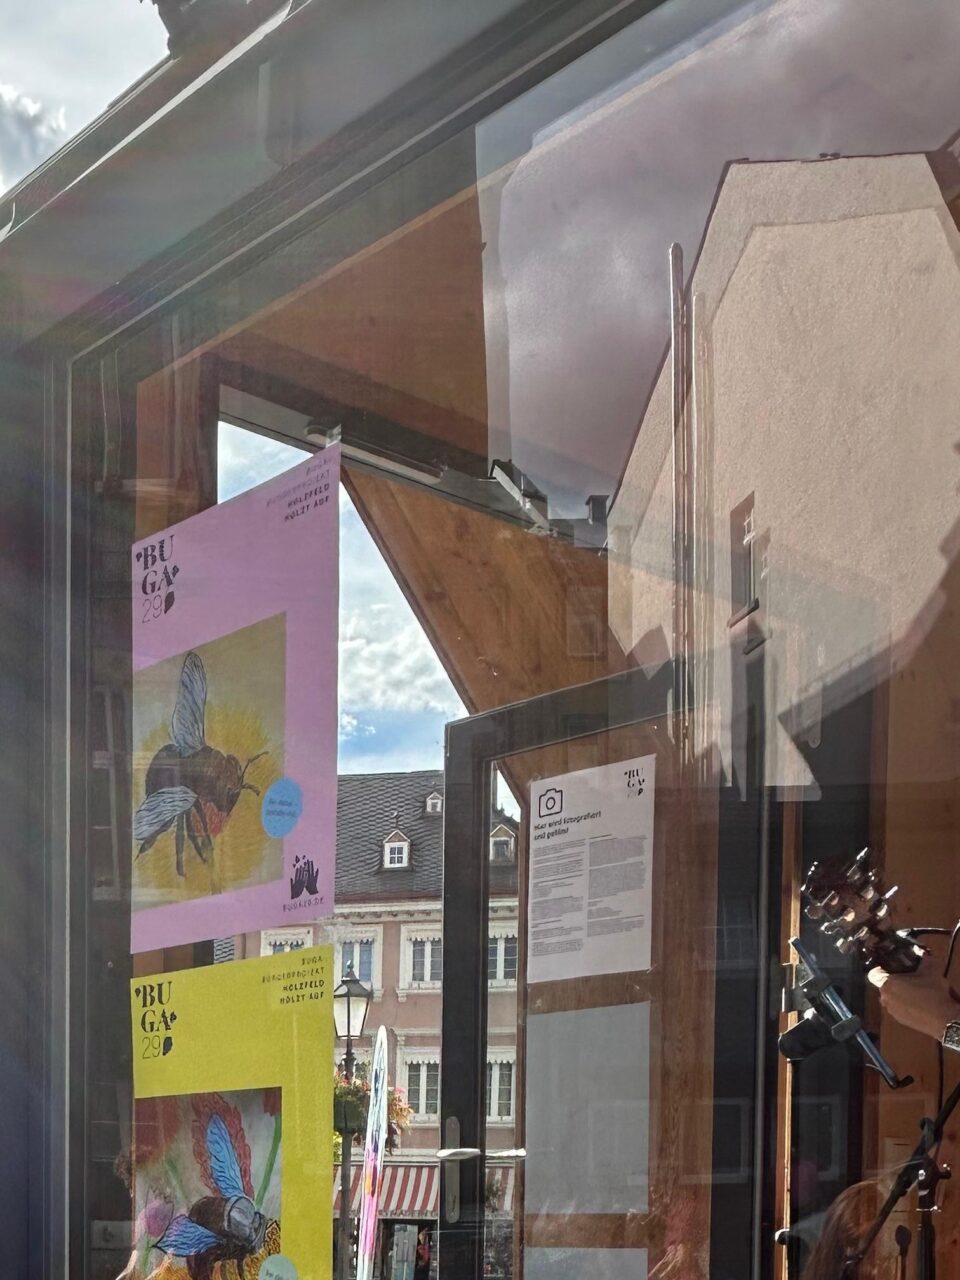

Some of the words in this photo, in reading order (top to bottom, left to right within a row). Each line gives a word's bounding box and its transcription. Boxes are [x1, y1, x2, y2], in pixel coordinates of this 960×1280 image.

[142, 535, 175, 570] BU
[141, 565, 174, 595] GA
[142, 594, 163, 624] 29
[140, 981, 173, 1008] BU
[140, 1008, 172, 1033] GA
[141, 1035, 161, 1059] 29
